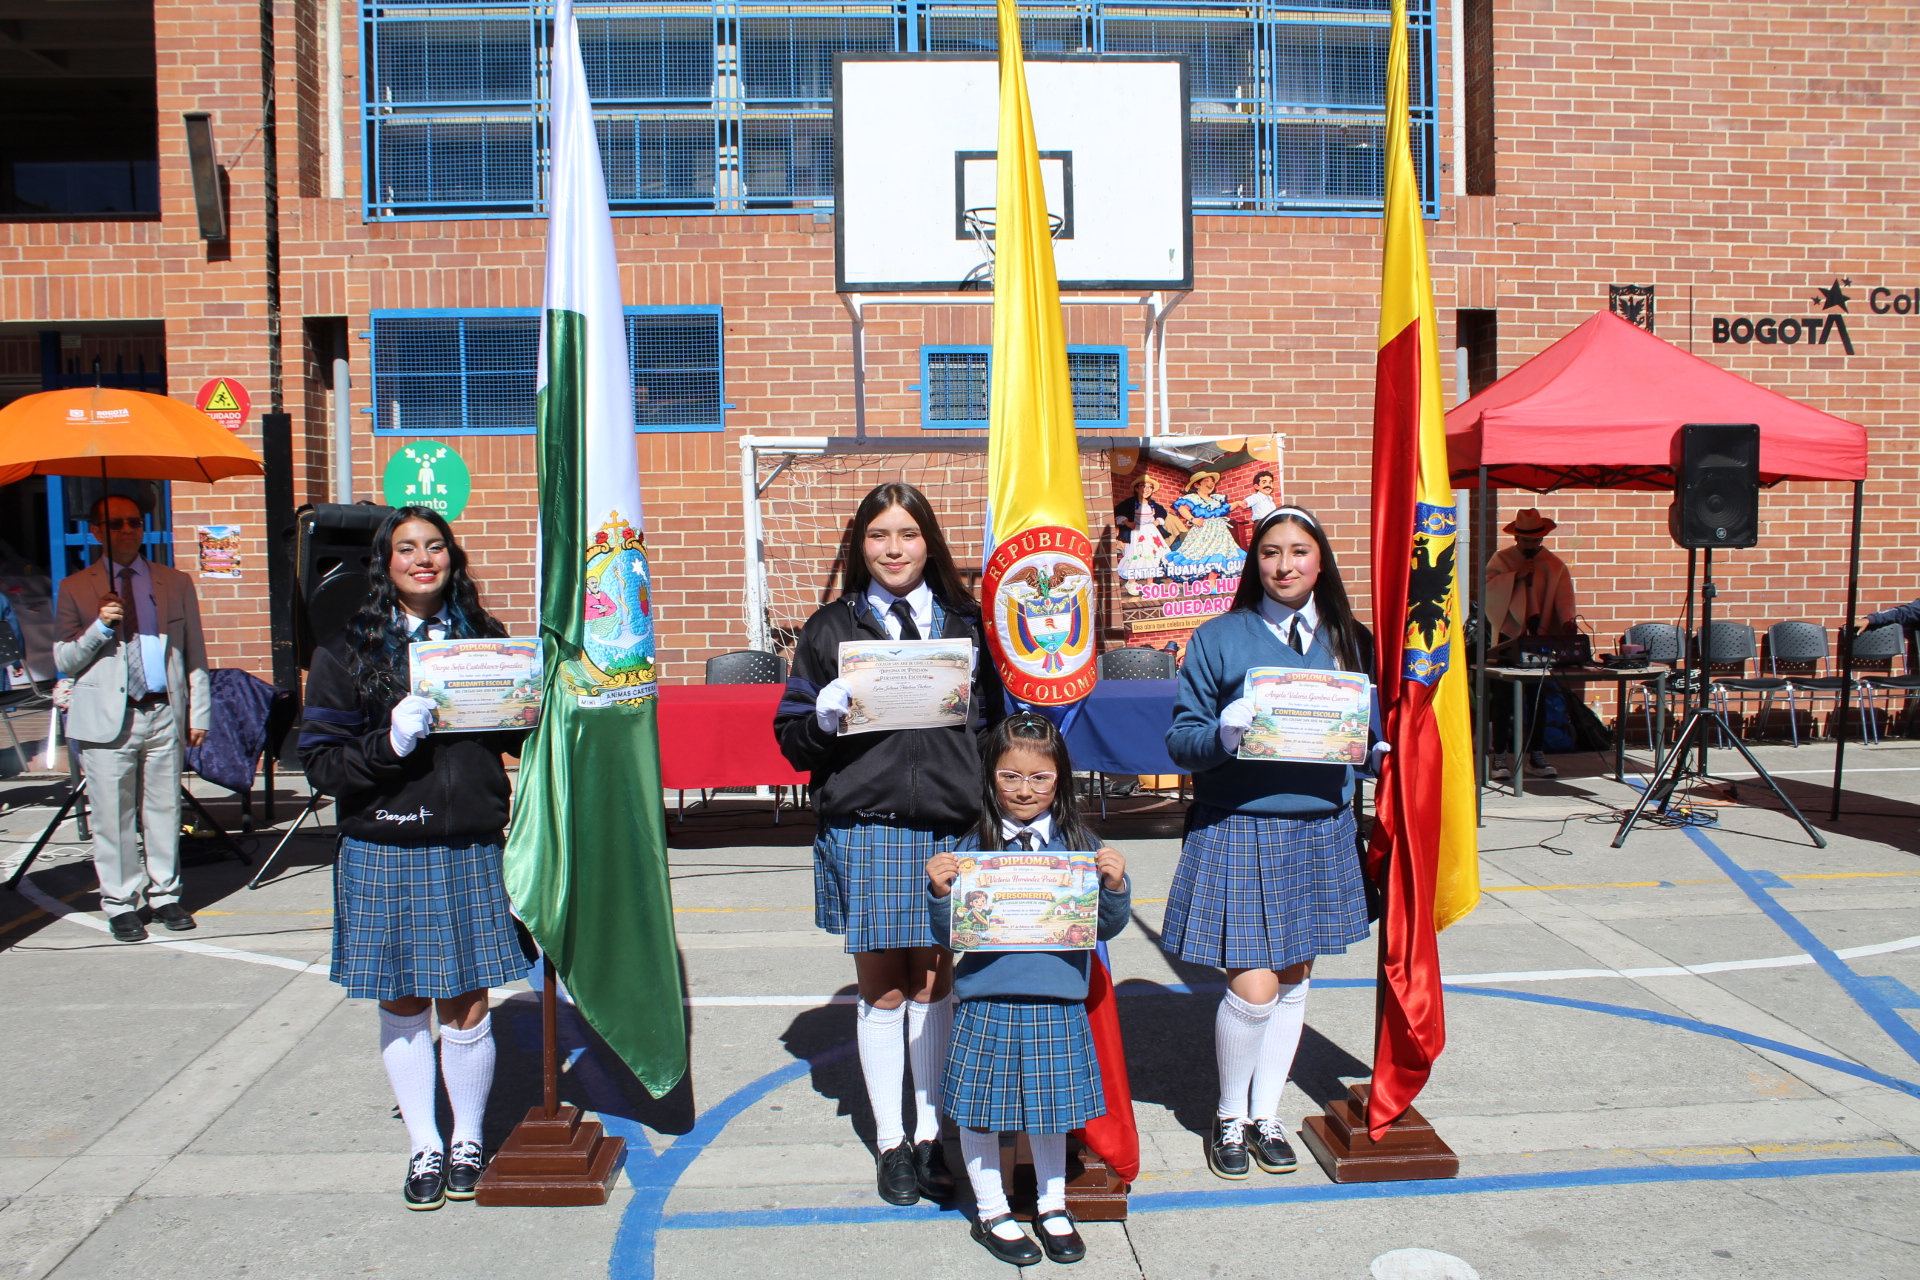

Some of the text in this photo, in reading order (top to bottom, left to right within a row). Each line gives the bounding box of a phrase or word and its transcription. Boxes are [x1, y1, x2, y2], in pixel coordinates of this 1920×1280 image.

[1869, 286, 1920, 315] Col
[1127, 559, 1245, 580] ENTRE RUANAS Y GU
[1183, 580, 1211, 597] LOS
[1216, 577, 1242, 594] HU
[1162, 596, 1235, 617] QUEDARO
[1133, 623, 1143, 631] Una
[1144, 622, 1155, 630] obra
[1156, 622, 1165, 630] que
[1166, 620, 1185, 628] celebra
[1185, 619, 1191, 627] la
[459, 643, 497, 651] DIPLOMA
[1292, 673, 1327, 682] DIPLOMA
[606, 690, 632, 700] ANIMAS
[1313, 710, 1340, 718] ESCOLAR
[374, 809, 418, 825] Dargie
[998, 856, 1051, 866] DIPLOMA
[1012, 875, 1040, 883] Hernández
[995, 892, 1053, 901] PERSONERITA
